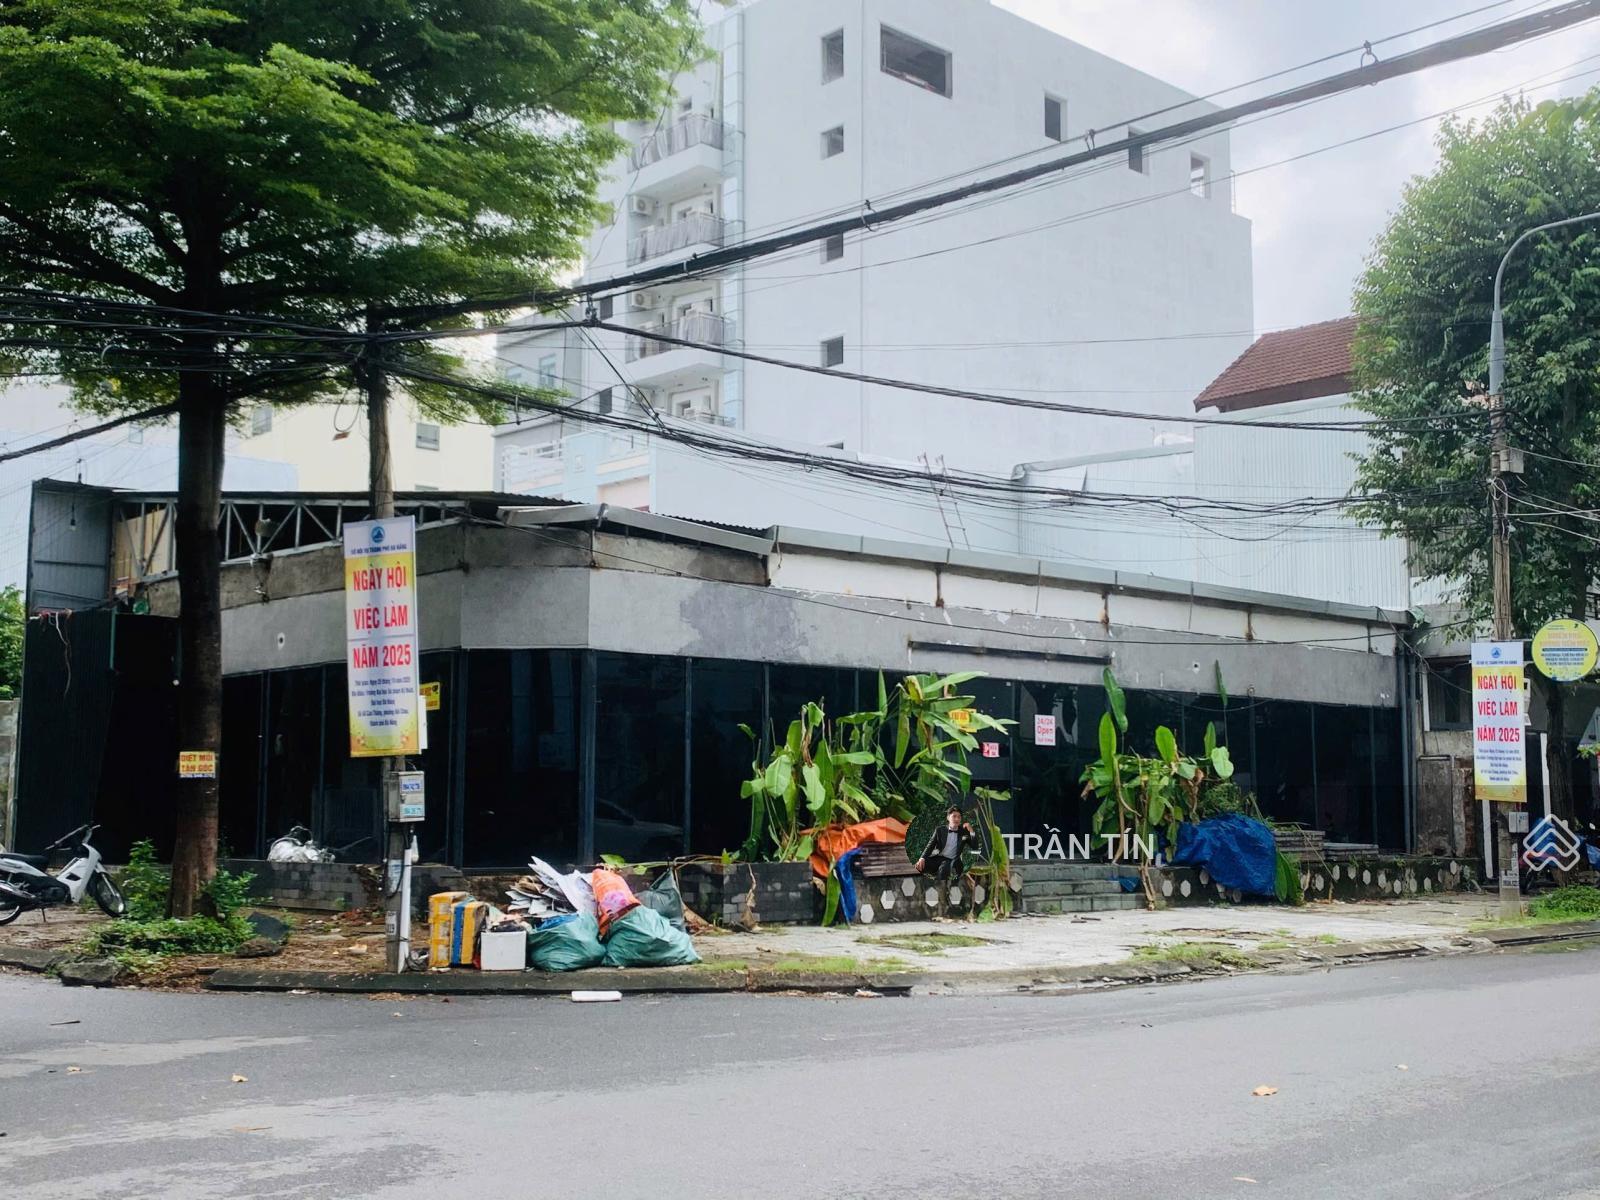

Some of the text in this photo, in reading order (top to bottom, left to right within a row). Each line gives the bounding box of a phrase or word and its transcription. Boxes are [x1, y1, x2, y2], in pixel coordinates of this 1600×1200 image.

[353, 561, 407, 592] NGÀY HỘI
[353, 600, 408, 634] VIỆC LÀM
[353, 644, 412, 669] NĂM 2025
[1477, 672, 1517, 694] NGÀY HỘI
[1478, 698, 1518, 718] VIỆC LÀM
[1037, 726, 1054, 736] Open
[1477, 724, 1520, 742] NĂM 2025
